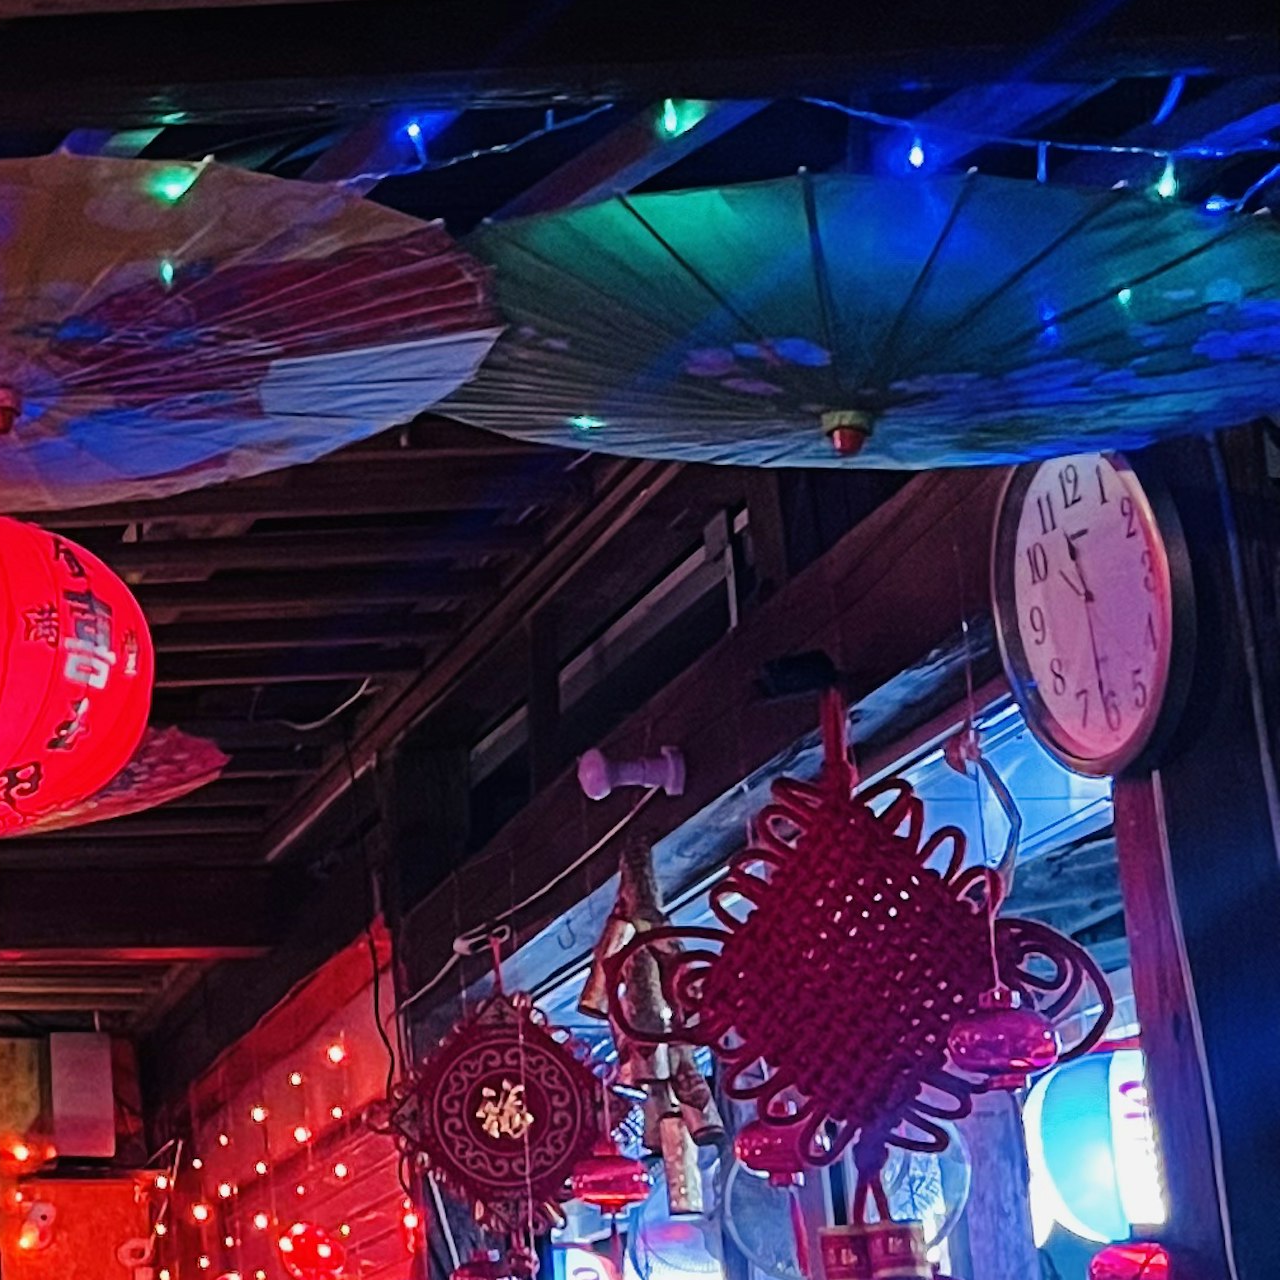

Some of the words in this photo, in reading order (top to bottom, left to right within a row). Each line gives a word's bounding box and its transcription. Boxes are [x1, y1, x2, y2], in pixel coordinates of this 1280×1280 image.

[1058, 464, 1082, 510] 12
[1094, 466, 1111, 506] 1
[1036, 493, 1057, 535] 11
[1120, 496, 1138, 539] 2
[1026, 542, 1048, 586] 10
[1028, 605, 1047, 646] 9
[1049, 657, 1067, 696] 8
[1130, 669, 1147, 710] 5
[1075, 689, 1090, 727] 7
[1103, 690, 1122, 733] 6
